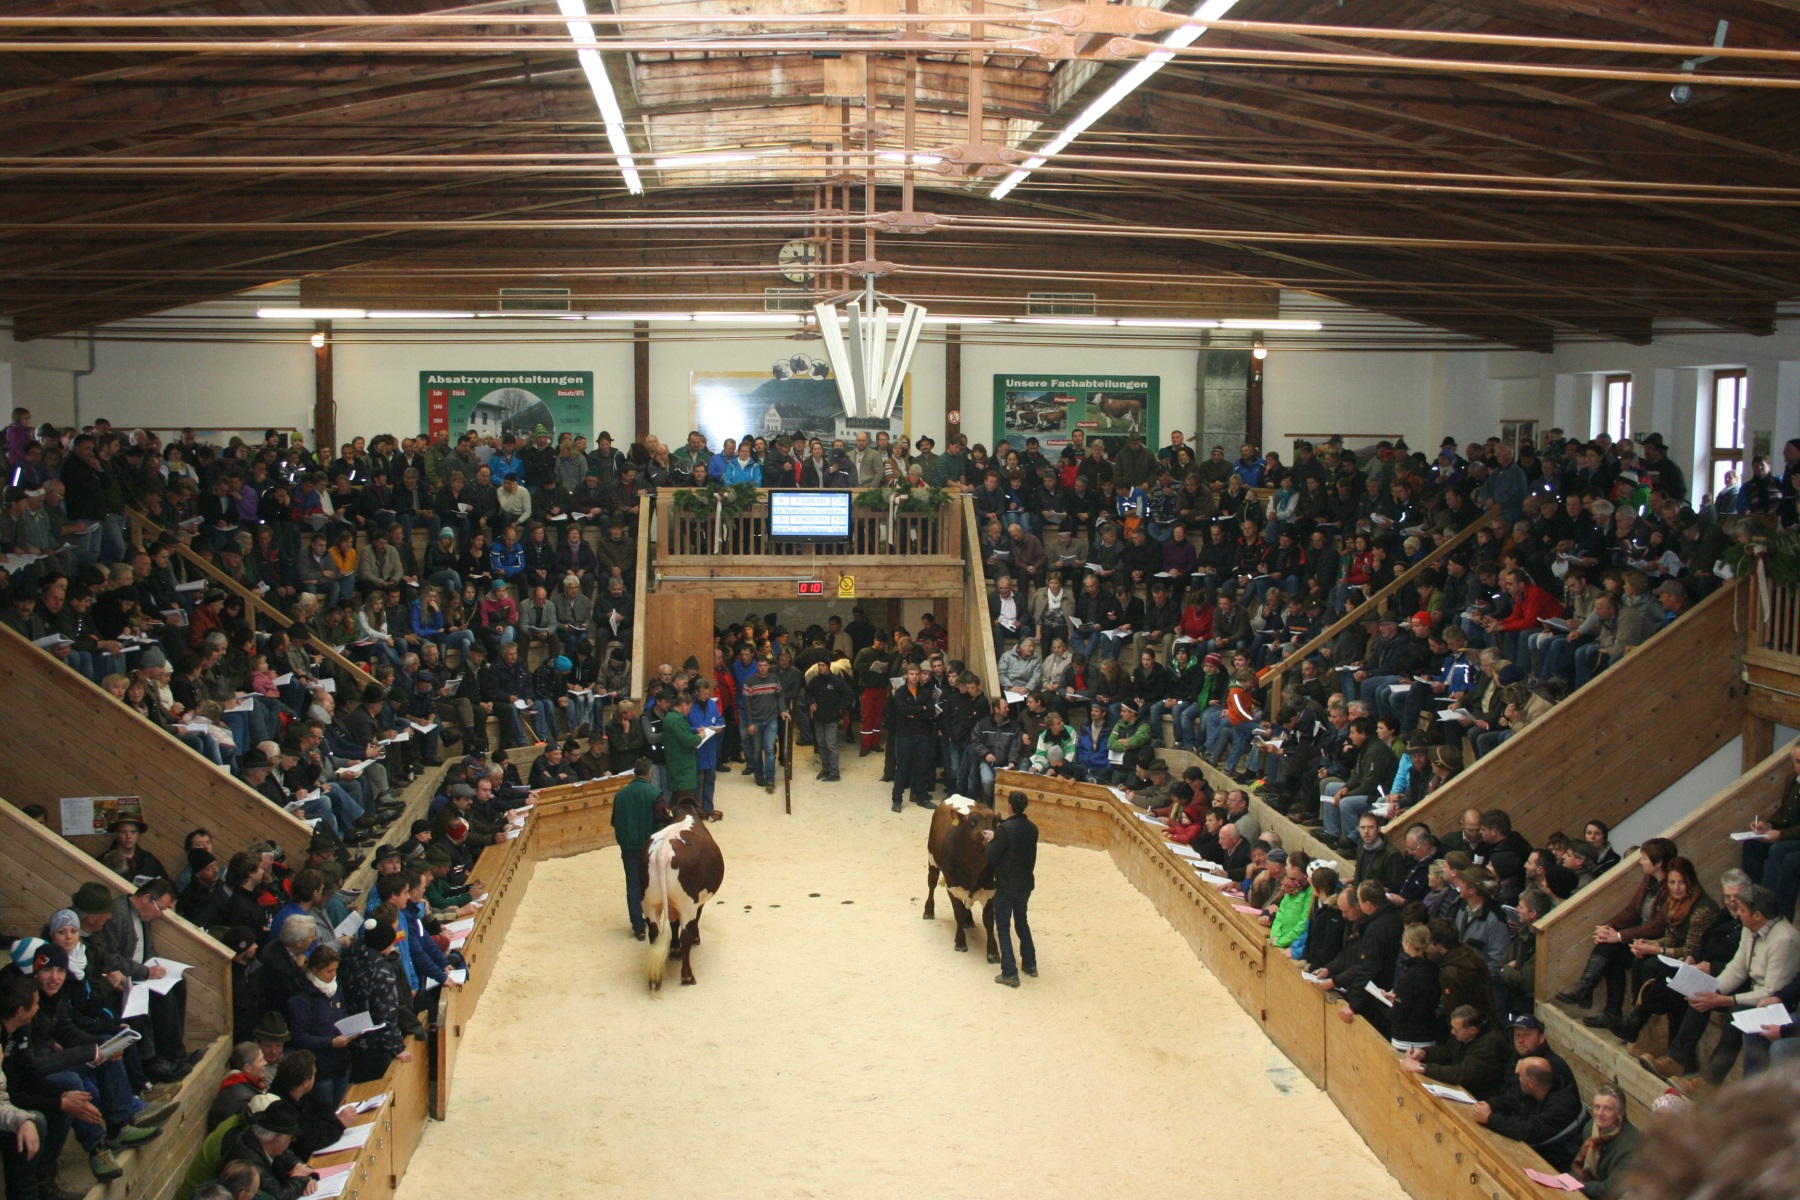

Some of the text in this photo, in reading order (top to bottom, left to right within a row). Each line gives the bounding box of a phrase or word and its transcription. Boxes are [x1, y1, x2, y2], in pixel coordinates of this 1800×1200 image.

[428, 375, 583, 385] Absatzveranstaltungen
[1005, 379, 1148, 389] Unsere Fachabteilungen
[800, 583, 821, 592] 010
